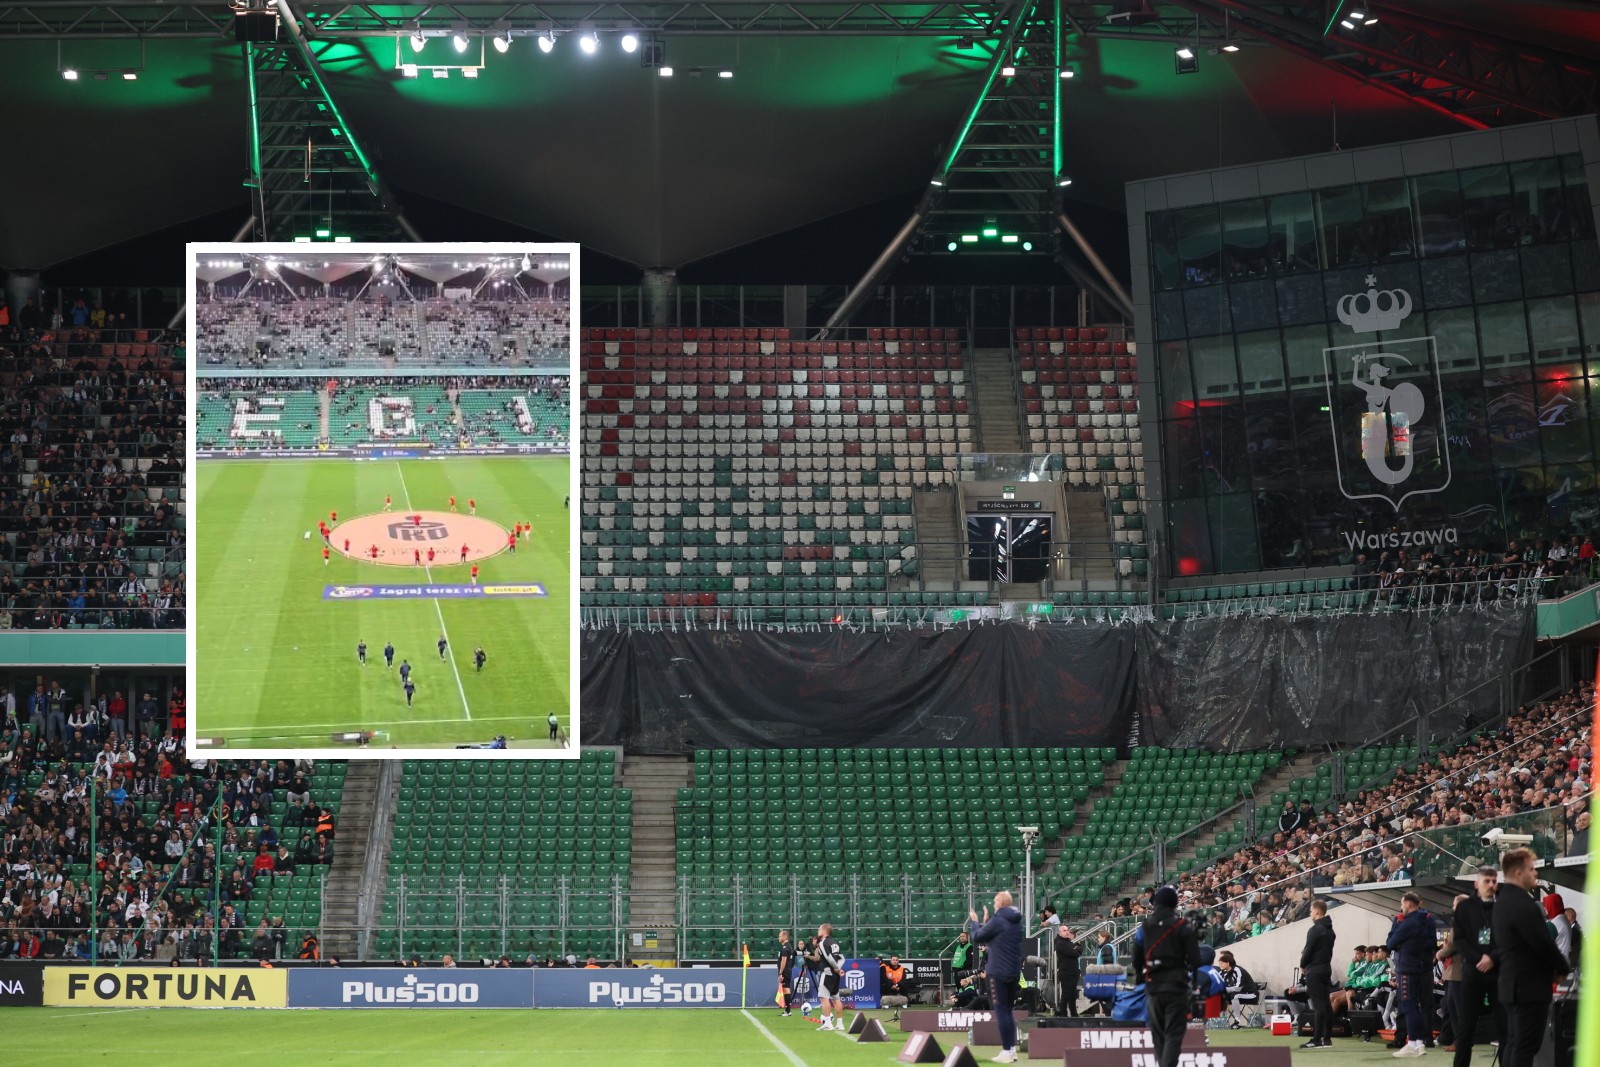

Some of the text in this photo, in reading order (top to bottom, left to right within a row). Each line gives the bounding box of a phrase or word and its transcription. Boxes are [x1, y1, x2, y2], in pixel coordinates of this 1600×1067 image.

[1343, 525, 1458, 551] Warszawa
[379, 587, 422, 596] Zagraj
[423, 587, 459, 595] teraz
[67, 973, 256, 1001] FORTUNA
[342, 974, 479, 1003] Plus500
[589, 974, 726, 1003] Plus500
